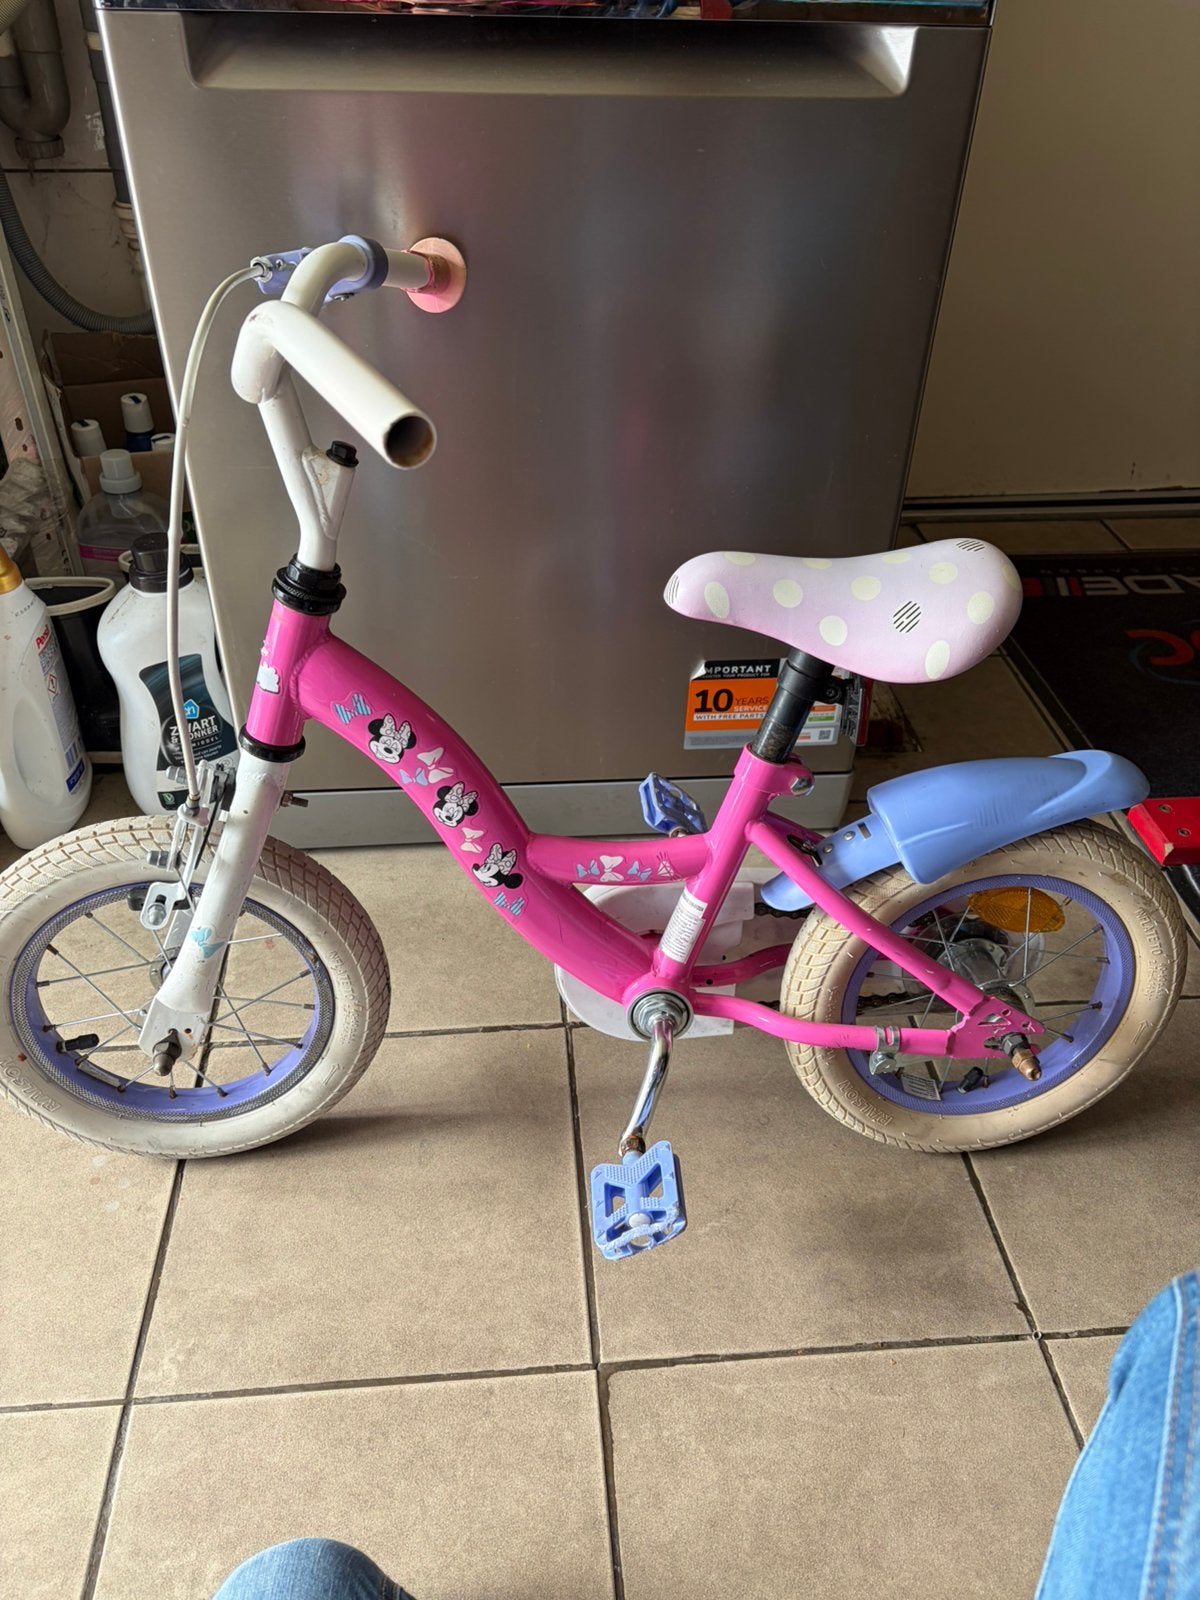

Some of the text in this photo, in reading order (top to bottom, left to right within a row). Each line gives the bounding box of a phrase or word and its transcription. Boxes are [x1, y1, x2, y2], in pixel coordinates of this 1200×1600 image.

[705, 665, 771, 674] MPORTANT
[694, 688, 769, 713] 10 YEARS
[734, 704, 768, 712] SERVICE
[187, 724, 219, 740] ONKER
[837, 1079, 895, 1127] RALSON
